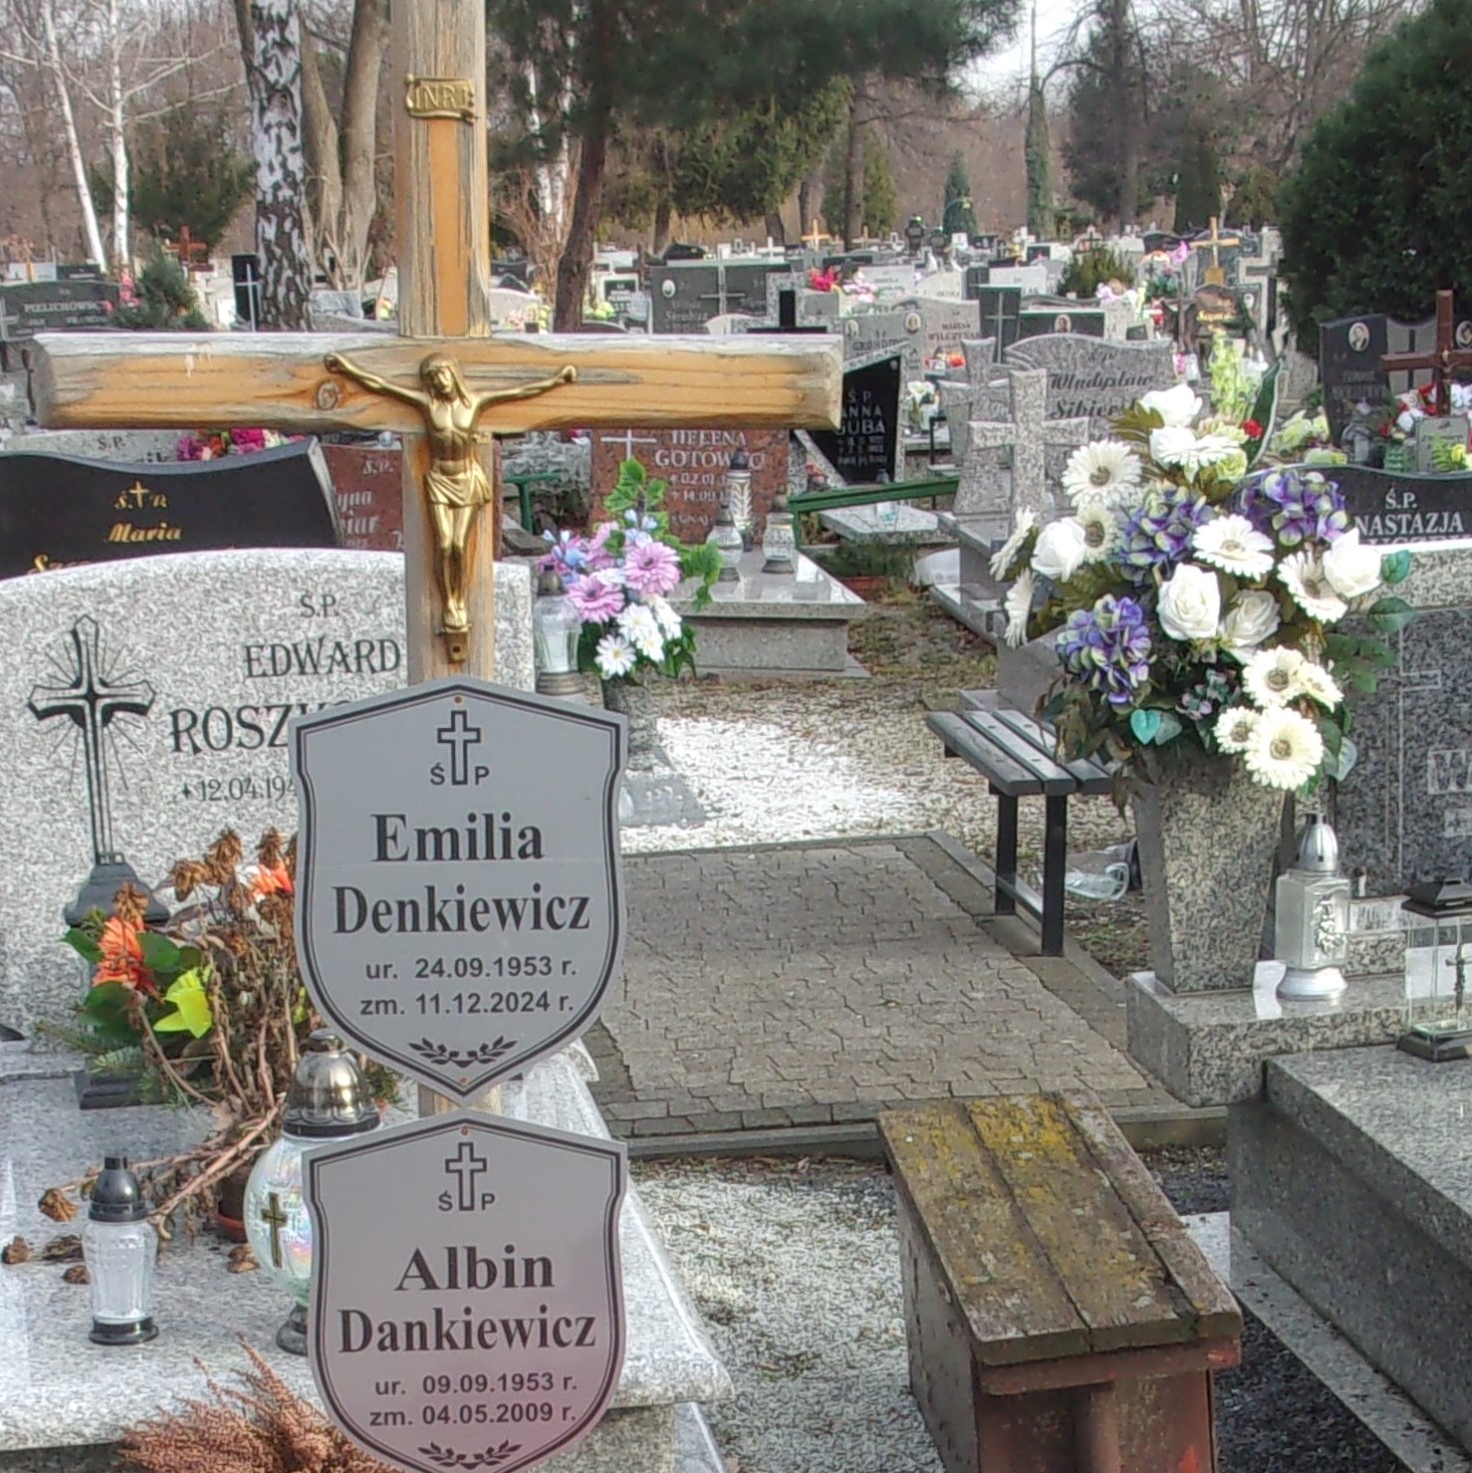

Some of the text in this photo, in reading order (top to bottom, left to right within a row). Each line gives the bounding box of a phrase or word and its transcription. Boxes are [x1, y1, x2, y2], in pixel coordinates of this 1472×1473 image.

[1384, 485, 1418, 510] Ś.P.
[104, 521, 183, 544] Maria
[1353, 511, 1466, 537] NASTAZJA
[244, 634, 403, 679] EDWARD
[169, 699, 349, 757] ROSZ
[429, 762, 490, 786] Ś P
[371, 812, 545, 862] Emilia
[331, 882, 591, 934] Denkiewicz
[365, 956, 577, 980] ur. 24.09.1953 r.
[360, 990, 574, 1016] zm. 11.12.2024 r.
[437, 1190, 496, 1213] Ś P
[393, 1244, 555, 1292] Albin
[337, 1304, 597, 1354] Dankiewicz
[375, 1372, 578, 1396] ur. 09.09.1953 r.
[369, 1403, 577, 1427] zm. 04.05.2009 r.
